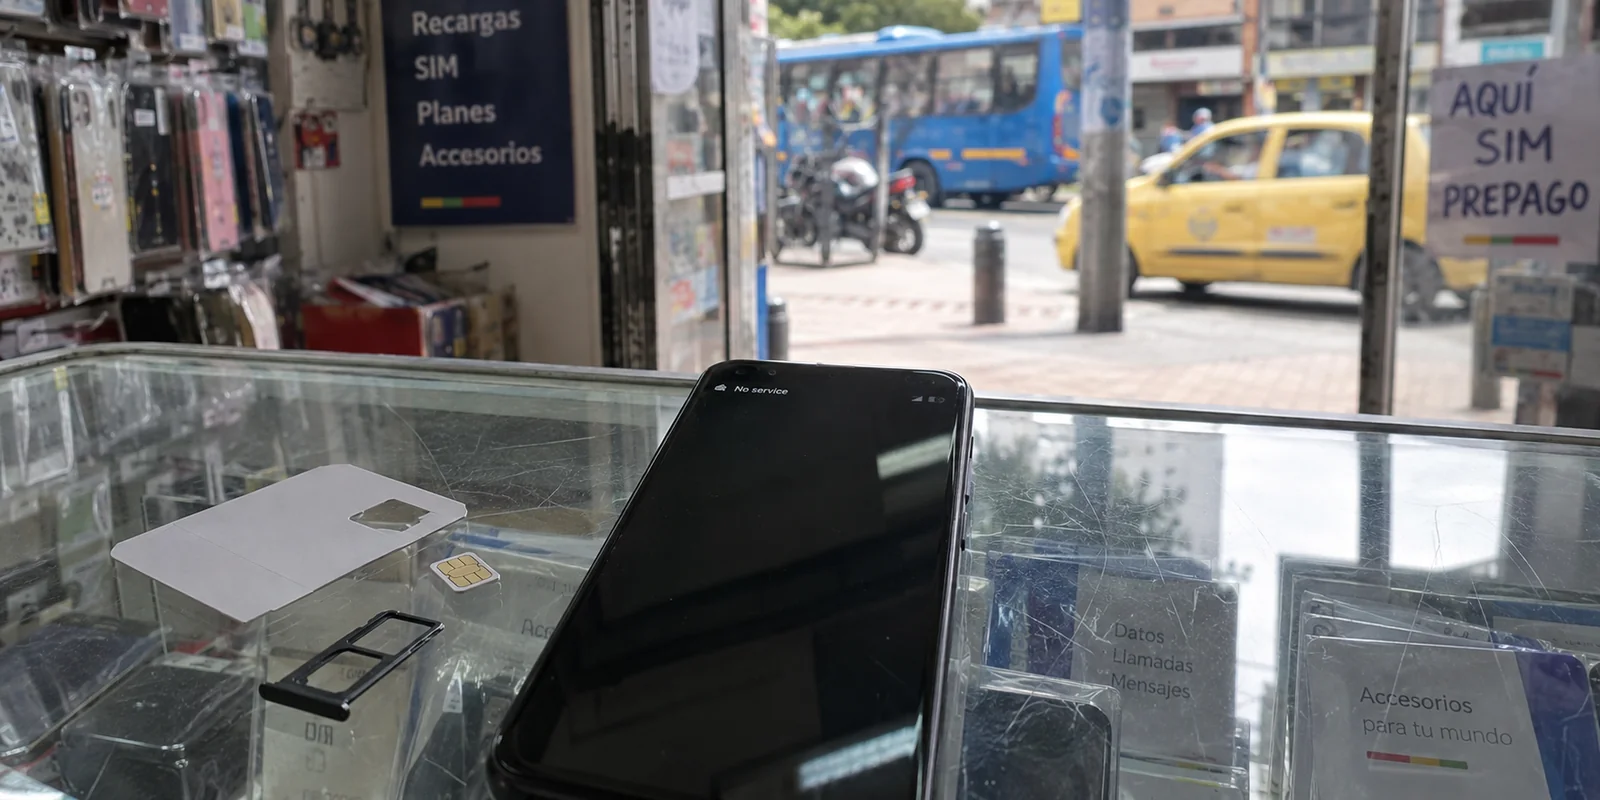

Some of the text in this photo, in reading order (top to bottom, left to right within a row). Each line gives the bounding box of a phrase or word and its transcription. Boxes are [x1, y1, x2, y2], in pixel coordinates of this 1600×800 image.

[411, 10, 521, 37] Recargas
[414, 53, 459, 80] SIM
[1449, 64, 1538, 118] AQUÍ
[416, 99, 497, 125] Planes
[419, 140, 543, 168] Accesorios
[1475, 123, 1553, 167] SIM
[1442, 179, 1590, 219] PREPAGO
[734, 385, 789, 395] No service
[1114, 622, 1165, 644] Datos
[1112, 647, 1193, 674] Llamadas
[1110, 672, 1191, 700] Mensajes
[1359, 686, 1473, 714] Accesorios
[1362, 717, 1513, 746] para tu mundo
